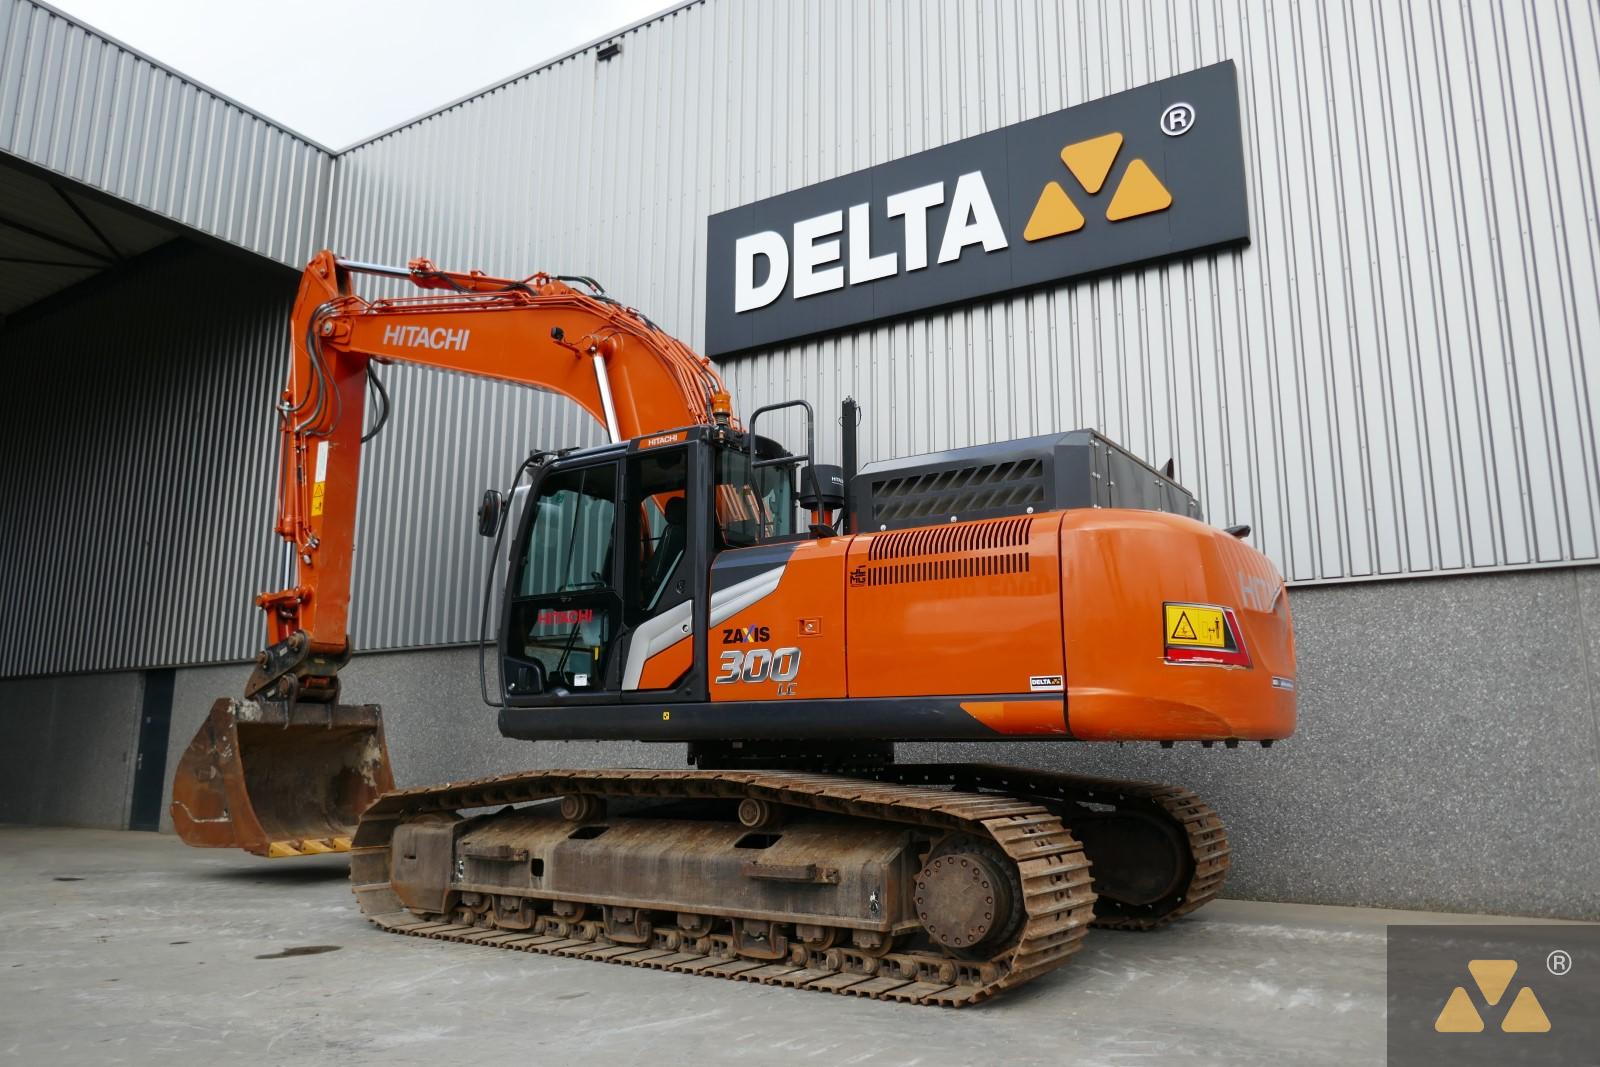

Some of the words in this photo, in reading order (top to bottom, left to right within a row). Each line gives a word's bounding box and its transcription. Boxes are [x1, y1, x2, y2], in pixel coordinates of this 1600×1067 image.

[734, 170, 1009, 314] DELTA
[383, 324, 471, 352] HITACHI
[648, 433, 678, 447] HITACHI
[537, 608, 593, 624] HITACHI
[722, 624, 770, 644] ZAXIS
[715, 647, 801, 684] 300
[778, 682, 797, 696] LC
[1032, 678, 1052, 686] DELTA
